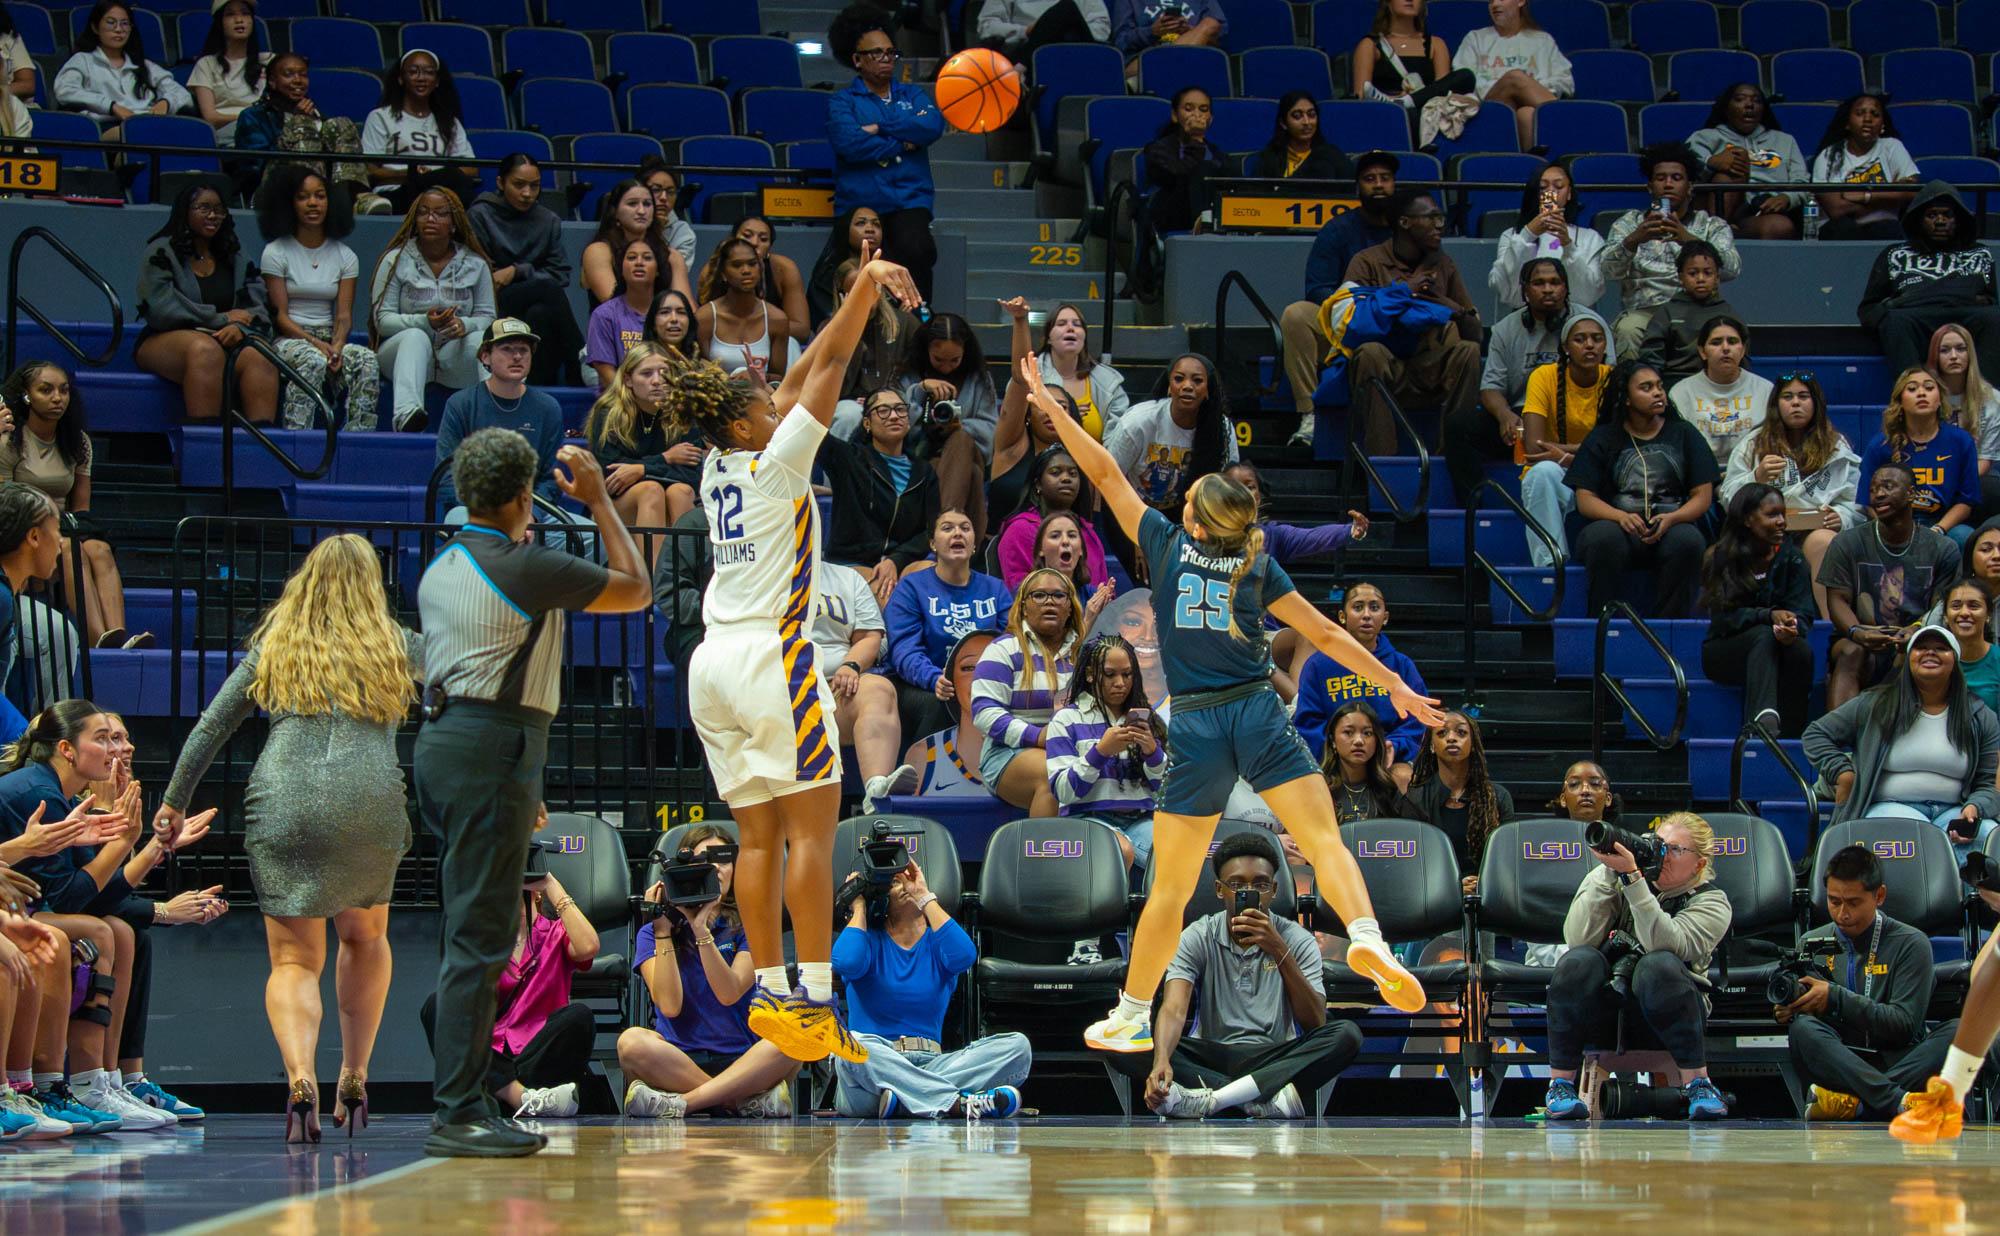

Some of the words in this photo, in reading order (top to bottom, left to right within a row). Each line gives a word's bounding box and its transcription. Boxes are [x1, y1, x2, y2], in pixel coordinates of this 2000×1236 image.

[0, 161, 42, 186] 18
[1232, 207, 1261, 217] SECTION
[1029, 246, 1081, 265] 225
[1088, 281, 1099, 299] A
[1696, 397, 1752, 412] LSU
[1912, 468, 1944, 485] SU
[711, 484, 745, 541] 12
[928, 597, 998, 619] LSU
[1176, 572, 1231, 631] 25
[656, 804, 704, 831] 18
[1025, 840, 1083, 857] LSU
[1358, 841, 1416, 858] LSU
[1523, 842, 1582, 860] LSU
[1709, 837, 1747, 855] SU
